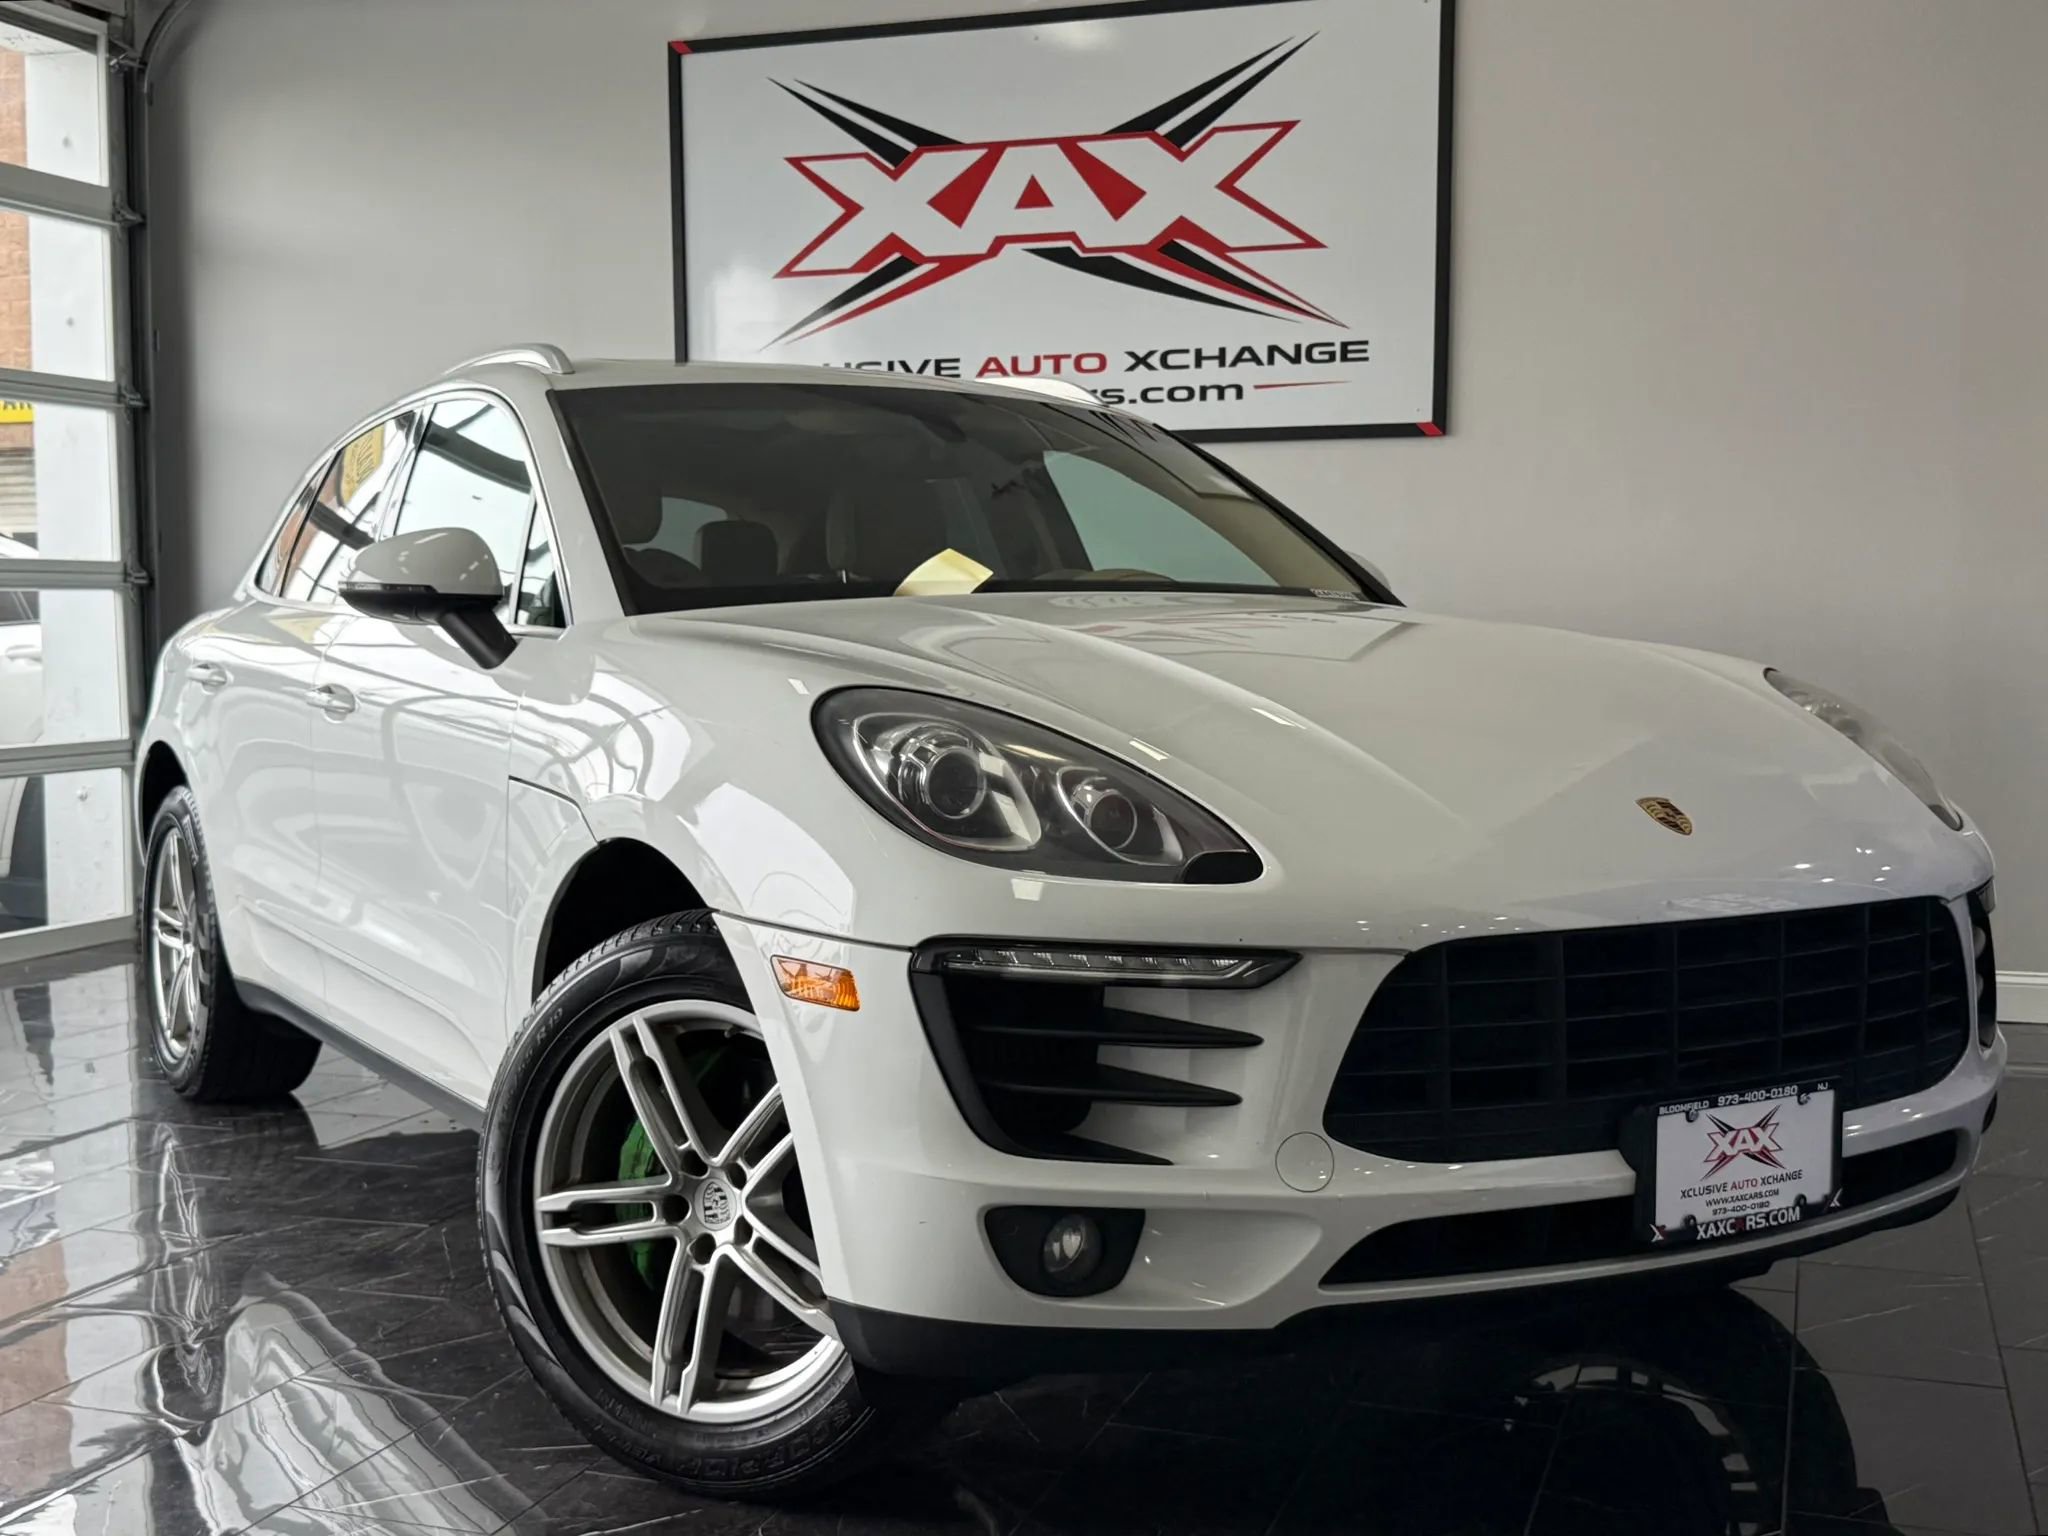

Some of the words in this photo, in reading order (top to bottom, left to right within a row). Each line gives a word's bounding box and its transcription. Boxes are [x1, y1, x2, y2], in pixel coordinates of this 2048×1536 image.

[772, 119, 1328, 278] XAX
[975, 352, 1108, 378] AUTO
[1124, 340, 1370, 372] XCHANGE
[1658, 1100, 1710, 1115] BLOOMFIELD
[1717, 1085, 1798, 1107] 973-400-0180
[1817, 1082, 1829, 1091] NJ
[1703, 1122, 1784, 1163] XAX
[1680, 1182, 1728, 1199] XCLUSIVE
[1730, 1178, 1758, 1191] AUTO
[1760, 1169, 1803, 1186] XCHANGE
[1705, 1188, 1780, 1208] WWW.XAXCARS.COM
[1712, 1201, 1770, 1216] 973-400-0180
